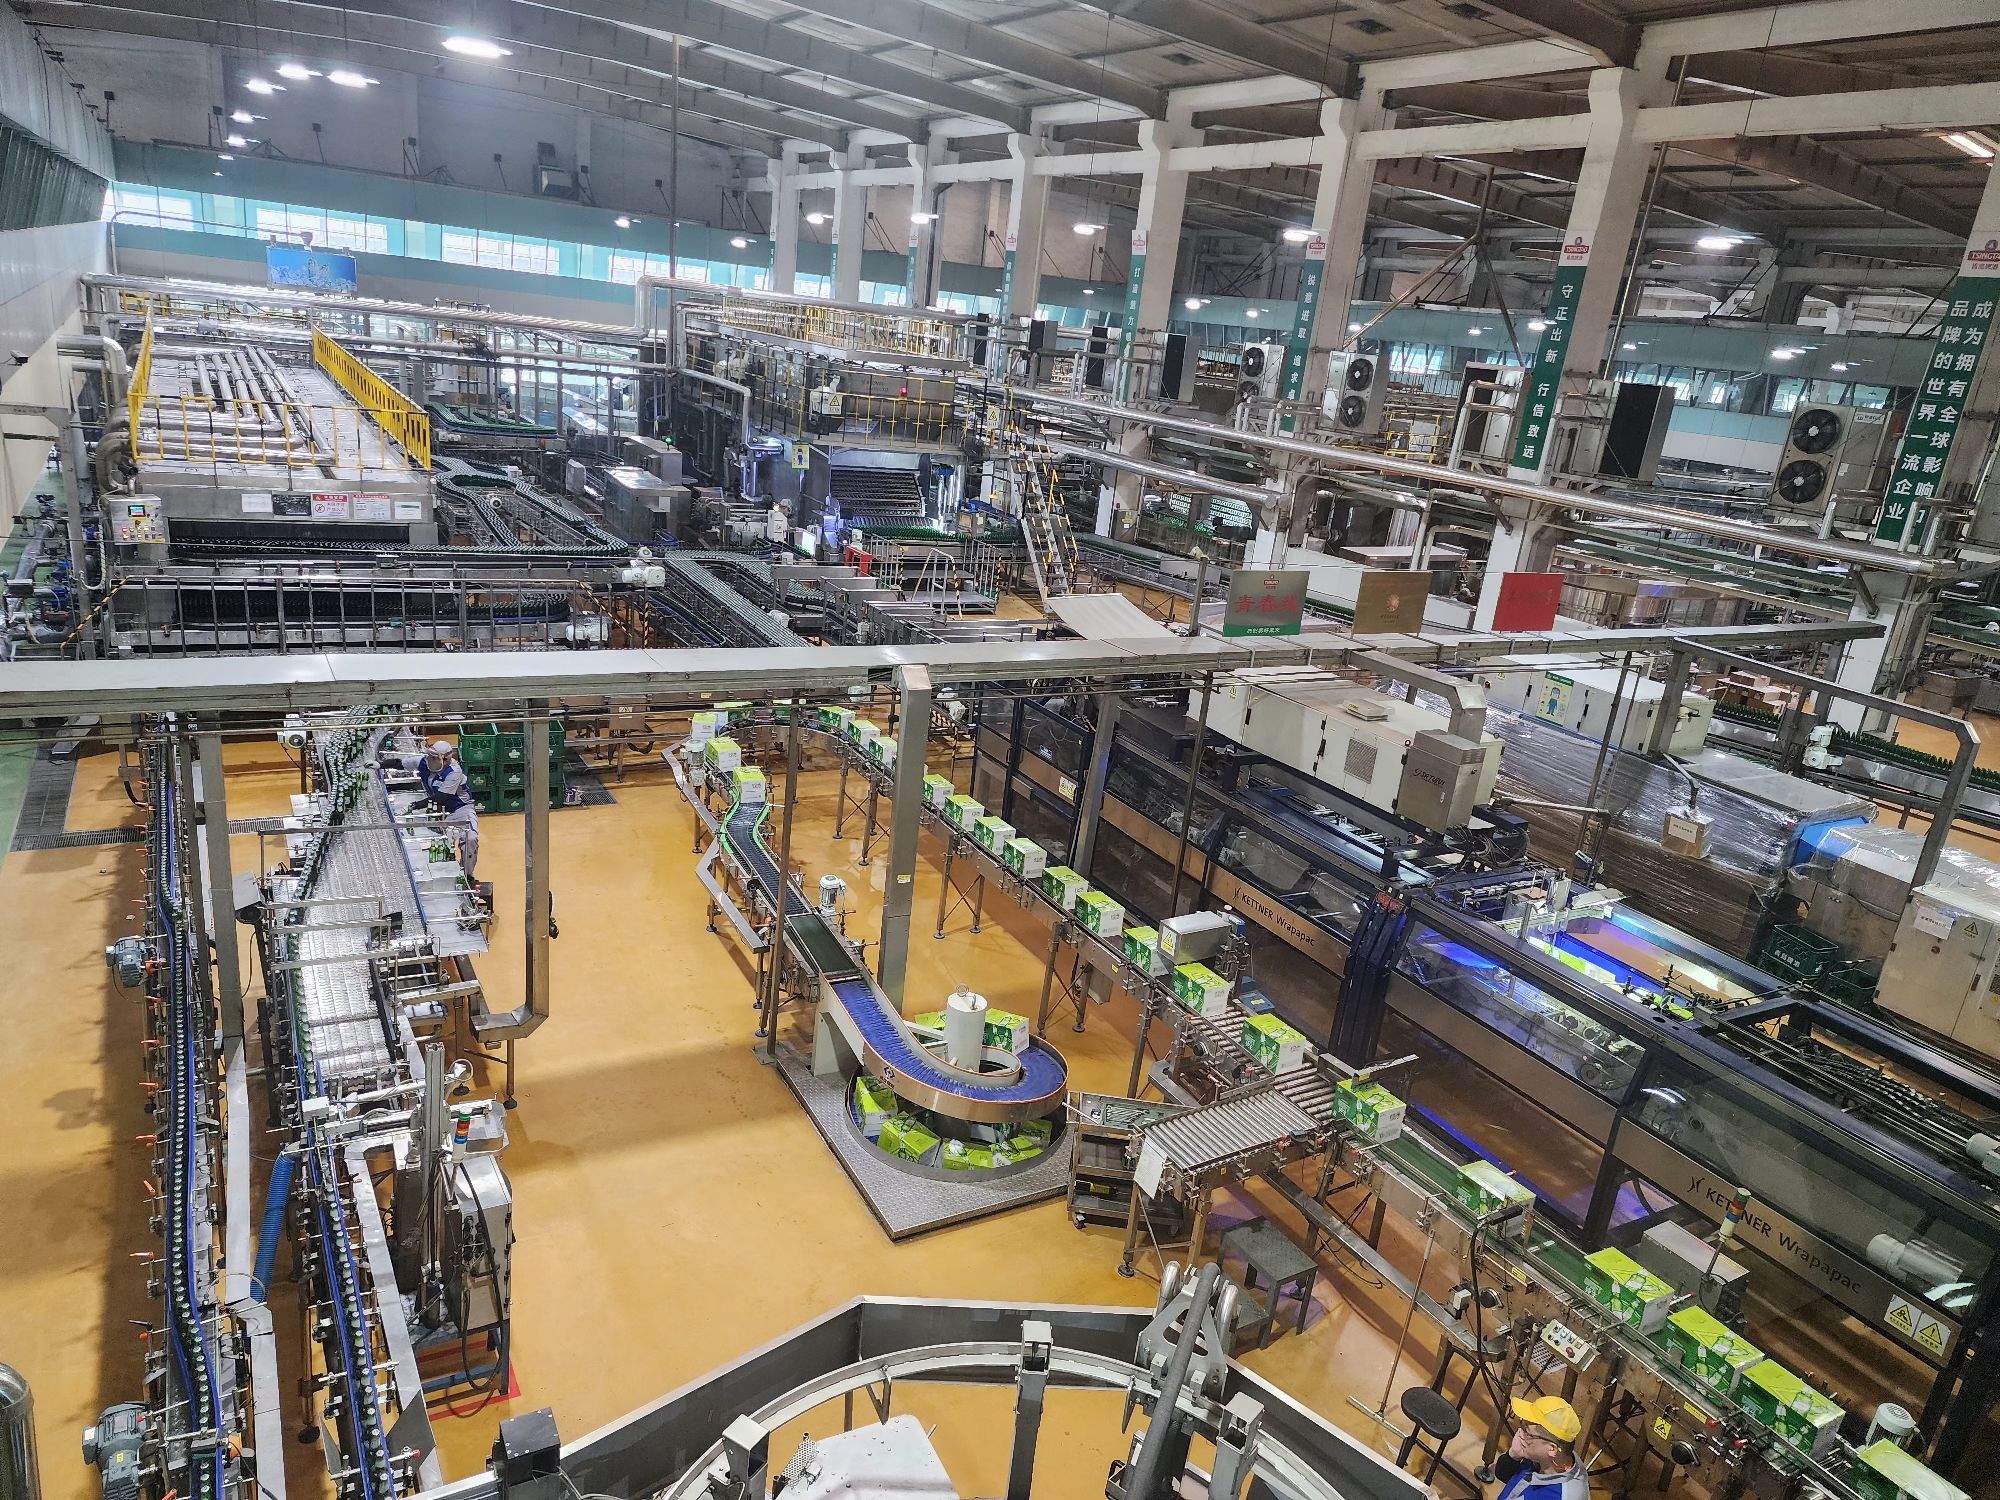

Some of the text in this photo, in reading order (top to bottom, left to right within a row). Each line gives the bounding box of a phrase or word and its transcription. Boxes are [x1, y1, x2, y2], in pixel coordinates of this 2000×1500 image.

[1298, 274, 1316, 338] 锐意进取
[1523, 284, 1574, 458] 守正出新 行信致远
[1885, 301, 1969, 520] 品牌的世界一流企业
[1241, 893, 1315, 946] KETTNER Wrapapac
[1706, 1188, 1861, 1294] KETNER Wrapapac
